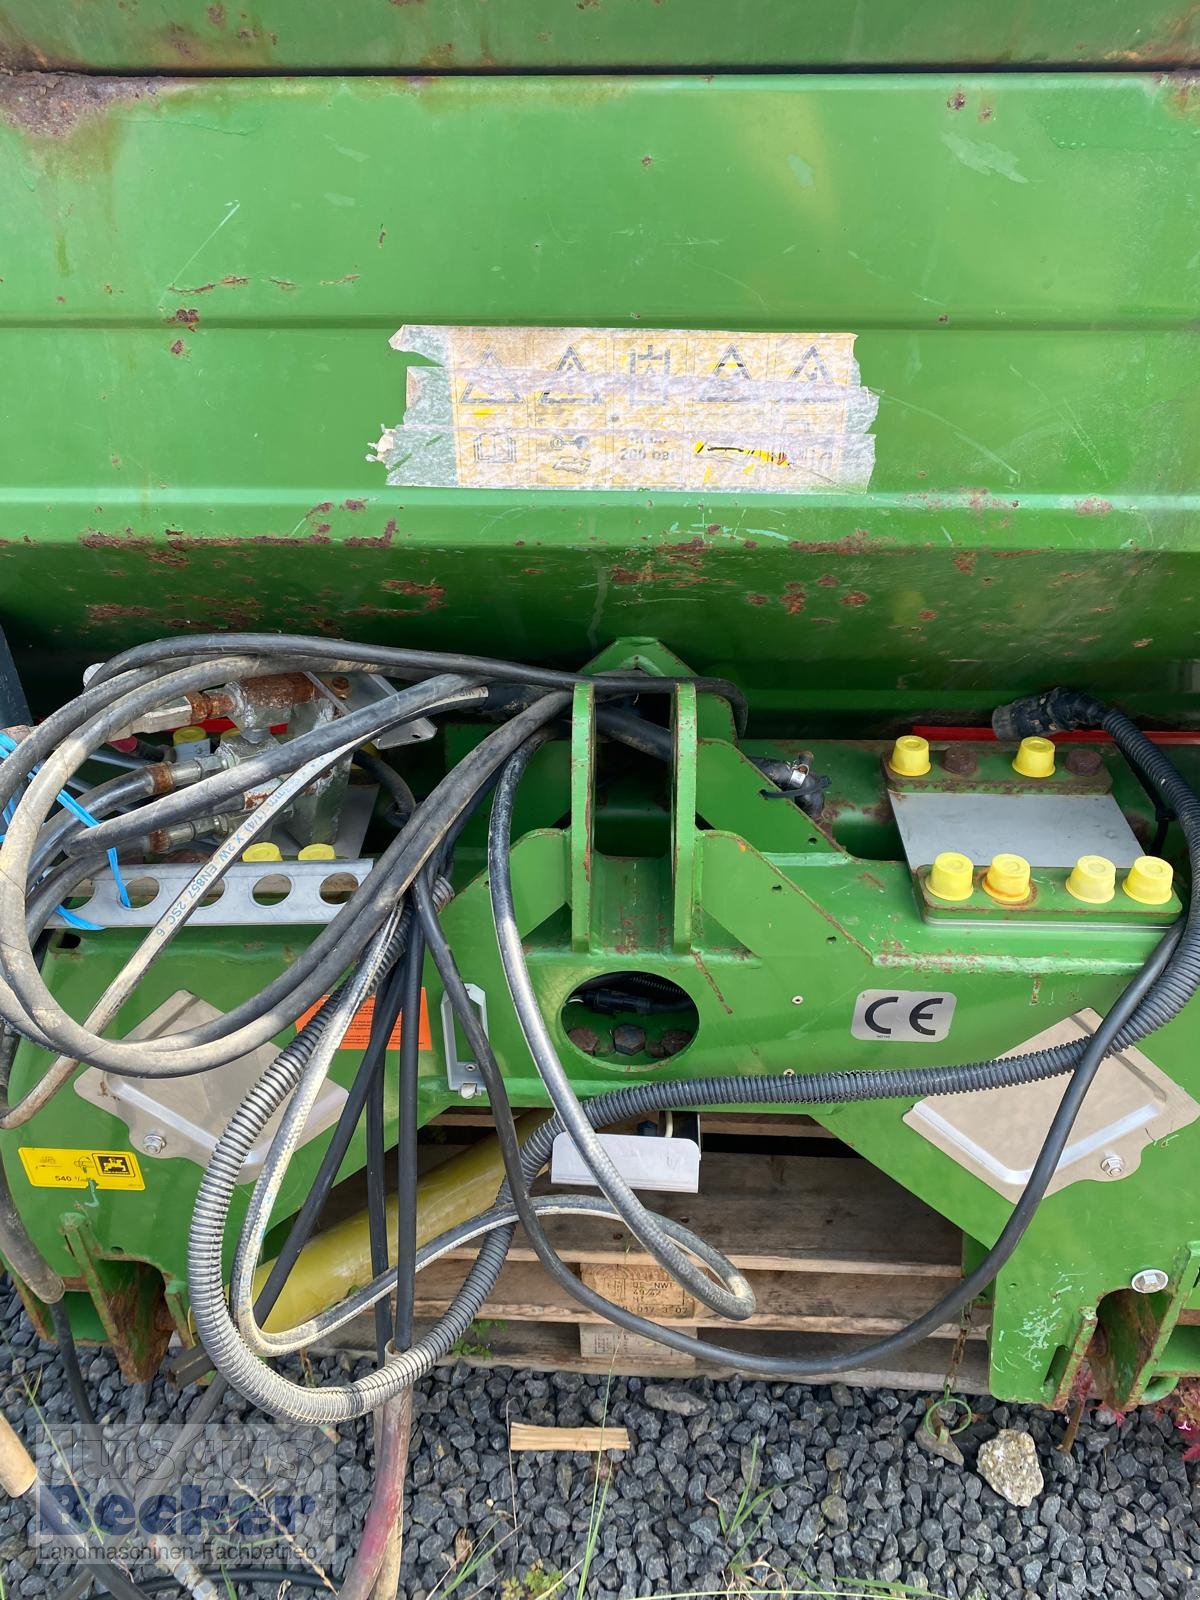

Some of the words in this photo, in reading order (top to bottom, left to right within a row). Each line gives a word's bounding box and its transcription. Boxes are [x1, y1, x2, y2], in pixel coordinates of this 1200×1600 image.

[187, 863, 218, 898] EN857
[165, 901, 188, 925] 2SC
[864, 996, 944, 1036] CE
